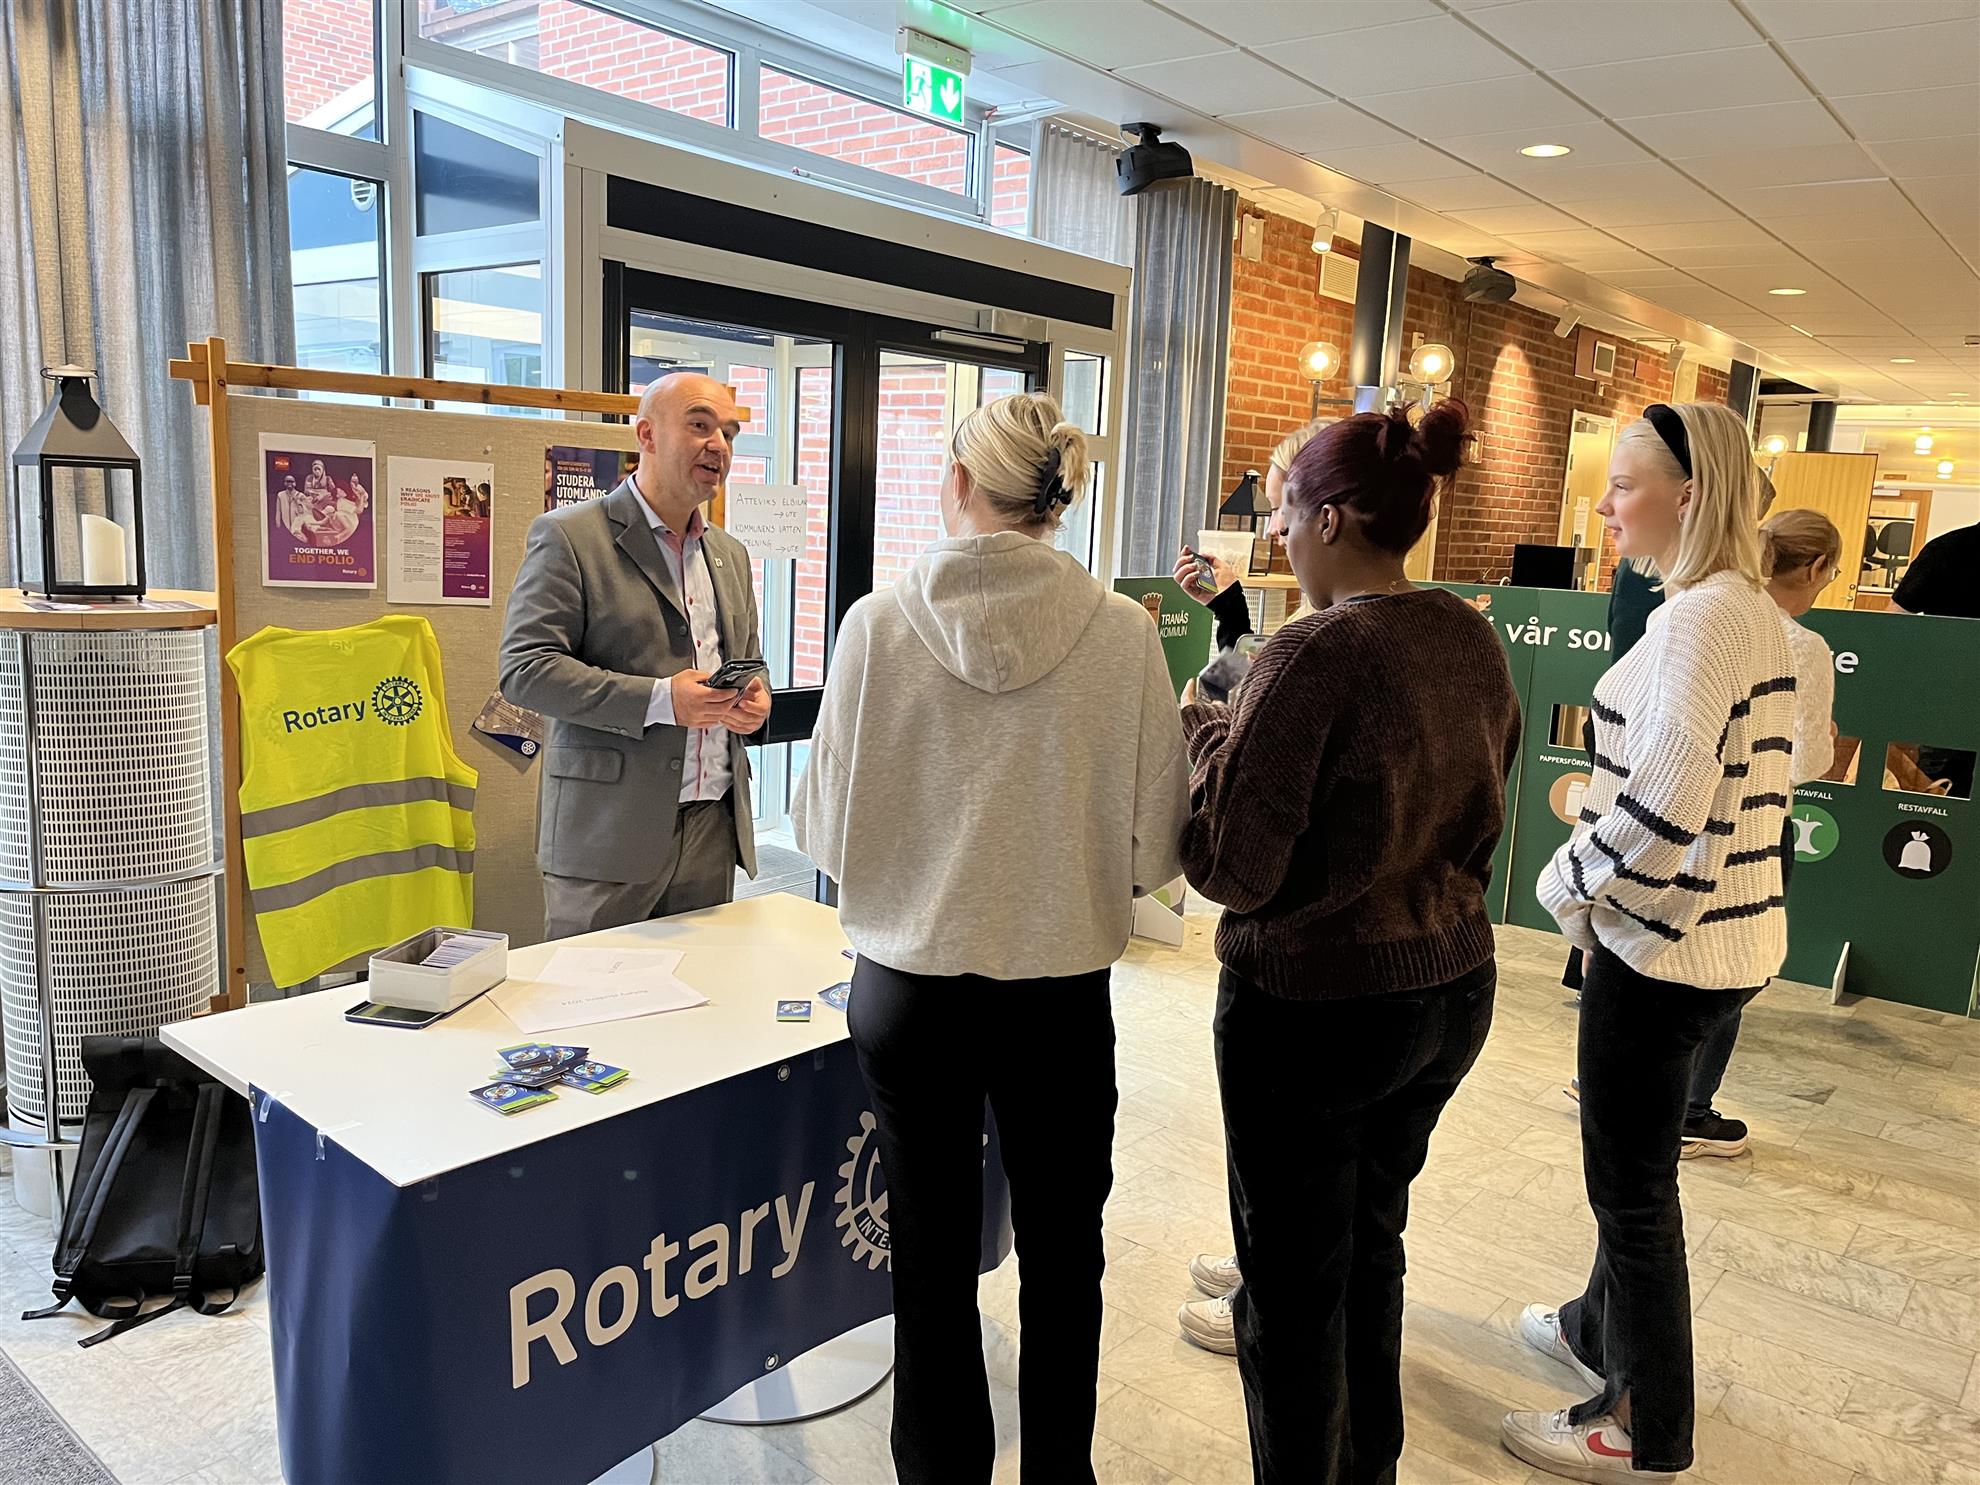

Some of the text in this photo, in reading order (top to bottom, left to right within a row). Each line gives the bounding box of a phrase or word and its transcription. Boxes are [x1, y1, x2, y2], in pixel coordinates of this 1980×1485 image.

[556, 474, 595, 488] STUDERA
[556, 487, 607, 500] UTOMLANDS
[288, 553, 355, 565] END POLIO
[294, 547, 336, 556] TOGETHER,
[1161, 609, 1189, 625] TRANÅS
[1159, 625, 1188, 638] KOMMUN
[1505, 616, 1558, 646] vår
[283, 700, 365, 733] Rotary
[1898, 802, 1949, 817] RESTAVFALL
[858, 1215, 892, 1249] INTE
[509, 1180, 815, 1389] Rotary
